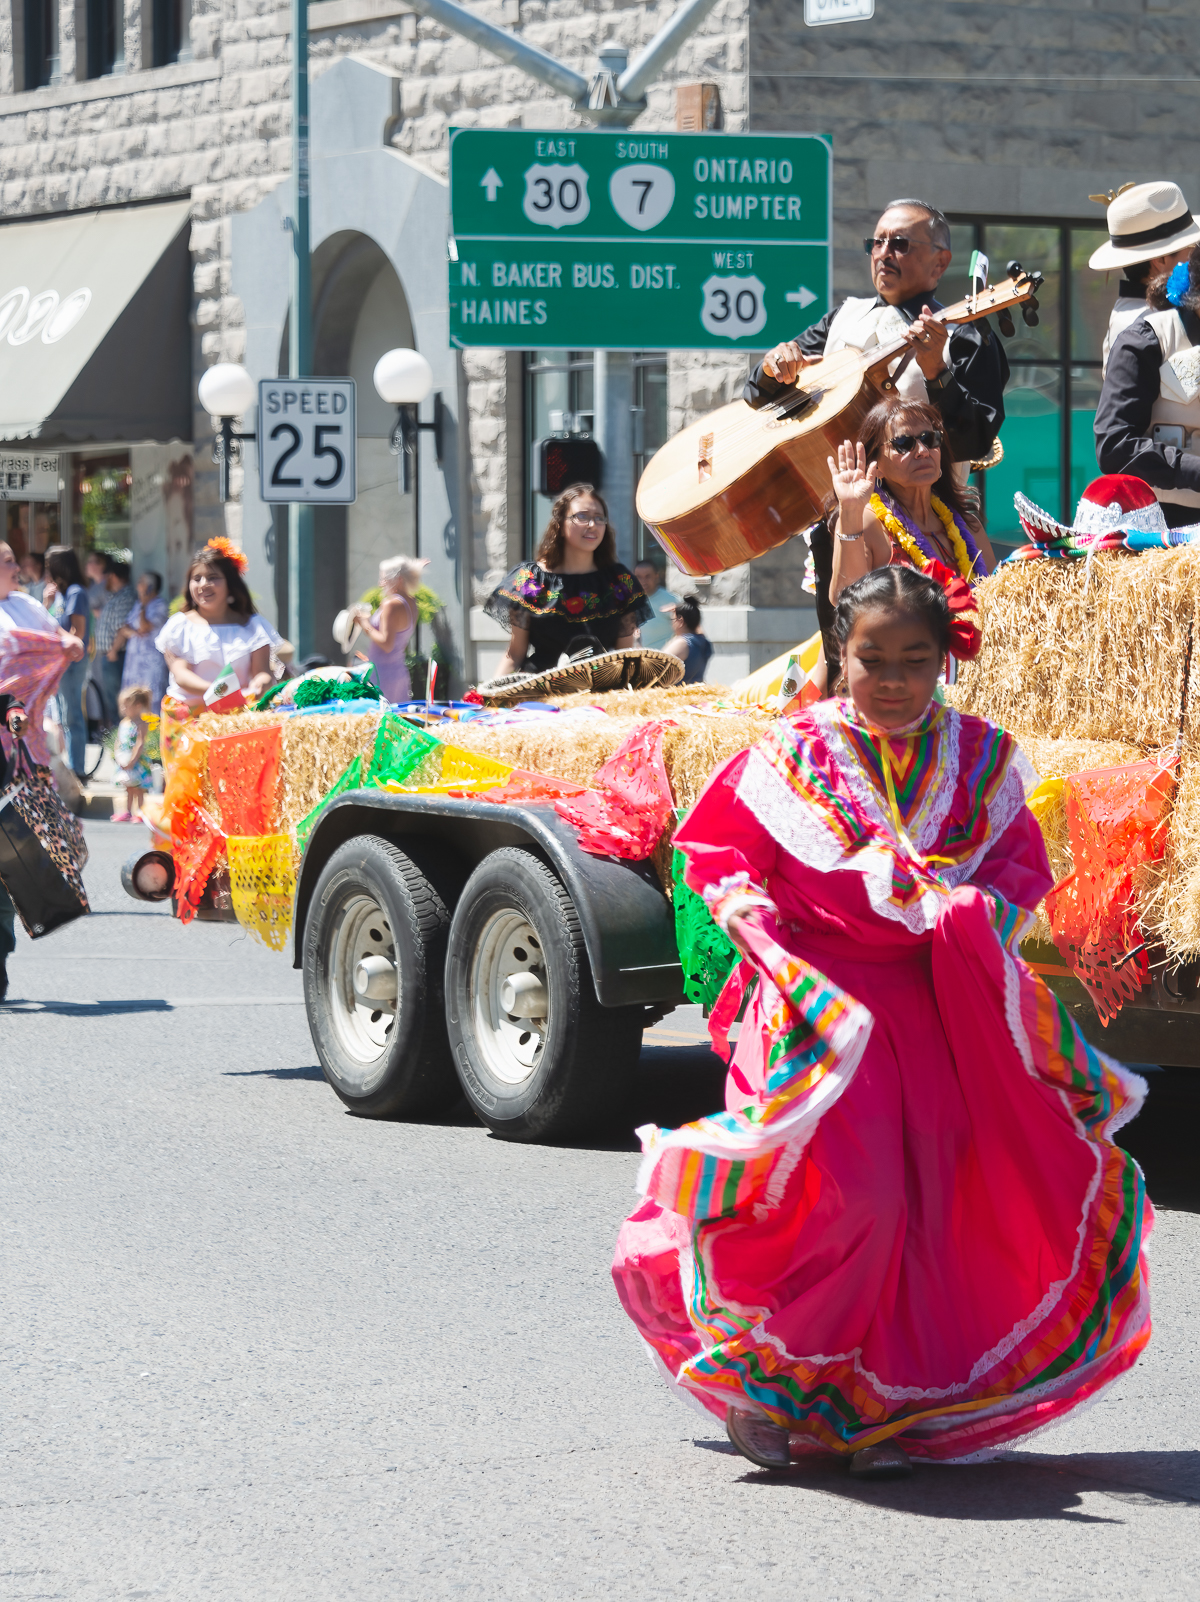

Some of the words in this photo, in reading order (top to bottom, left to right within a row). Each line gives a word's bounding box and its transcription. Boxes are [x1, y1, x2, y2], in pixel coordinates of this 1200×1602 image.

[536, 140, 576, 158] EAST
[615, 141, 669, 159] SOUTH
[694, 157, 793, 184] ONTARIO
[532, 177, 581, 213] 30
[630, 180, 655, 215] 7
[694, 194, 802, 221] SUMPTER
[712, 251, 755, 269] WEST
[460, 263, 480, 288] N.
[492, 263, 562, 289] BAKER
[573, 264, 619, 290] BUS.
[630, 266, 681, 290] DIST.
[460, 299, 548, 326] HAINES
[709, 288, 758, 324] 30
[265, 391, 348, 415] SPEED
[0, 459, 30, 471] rass
[270, 422, 344, 488] 25
